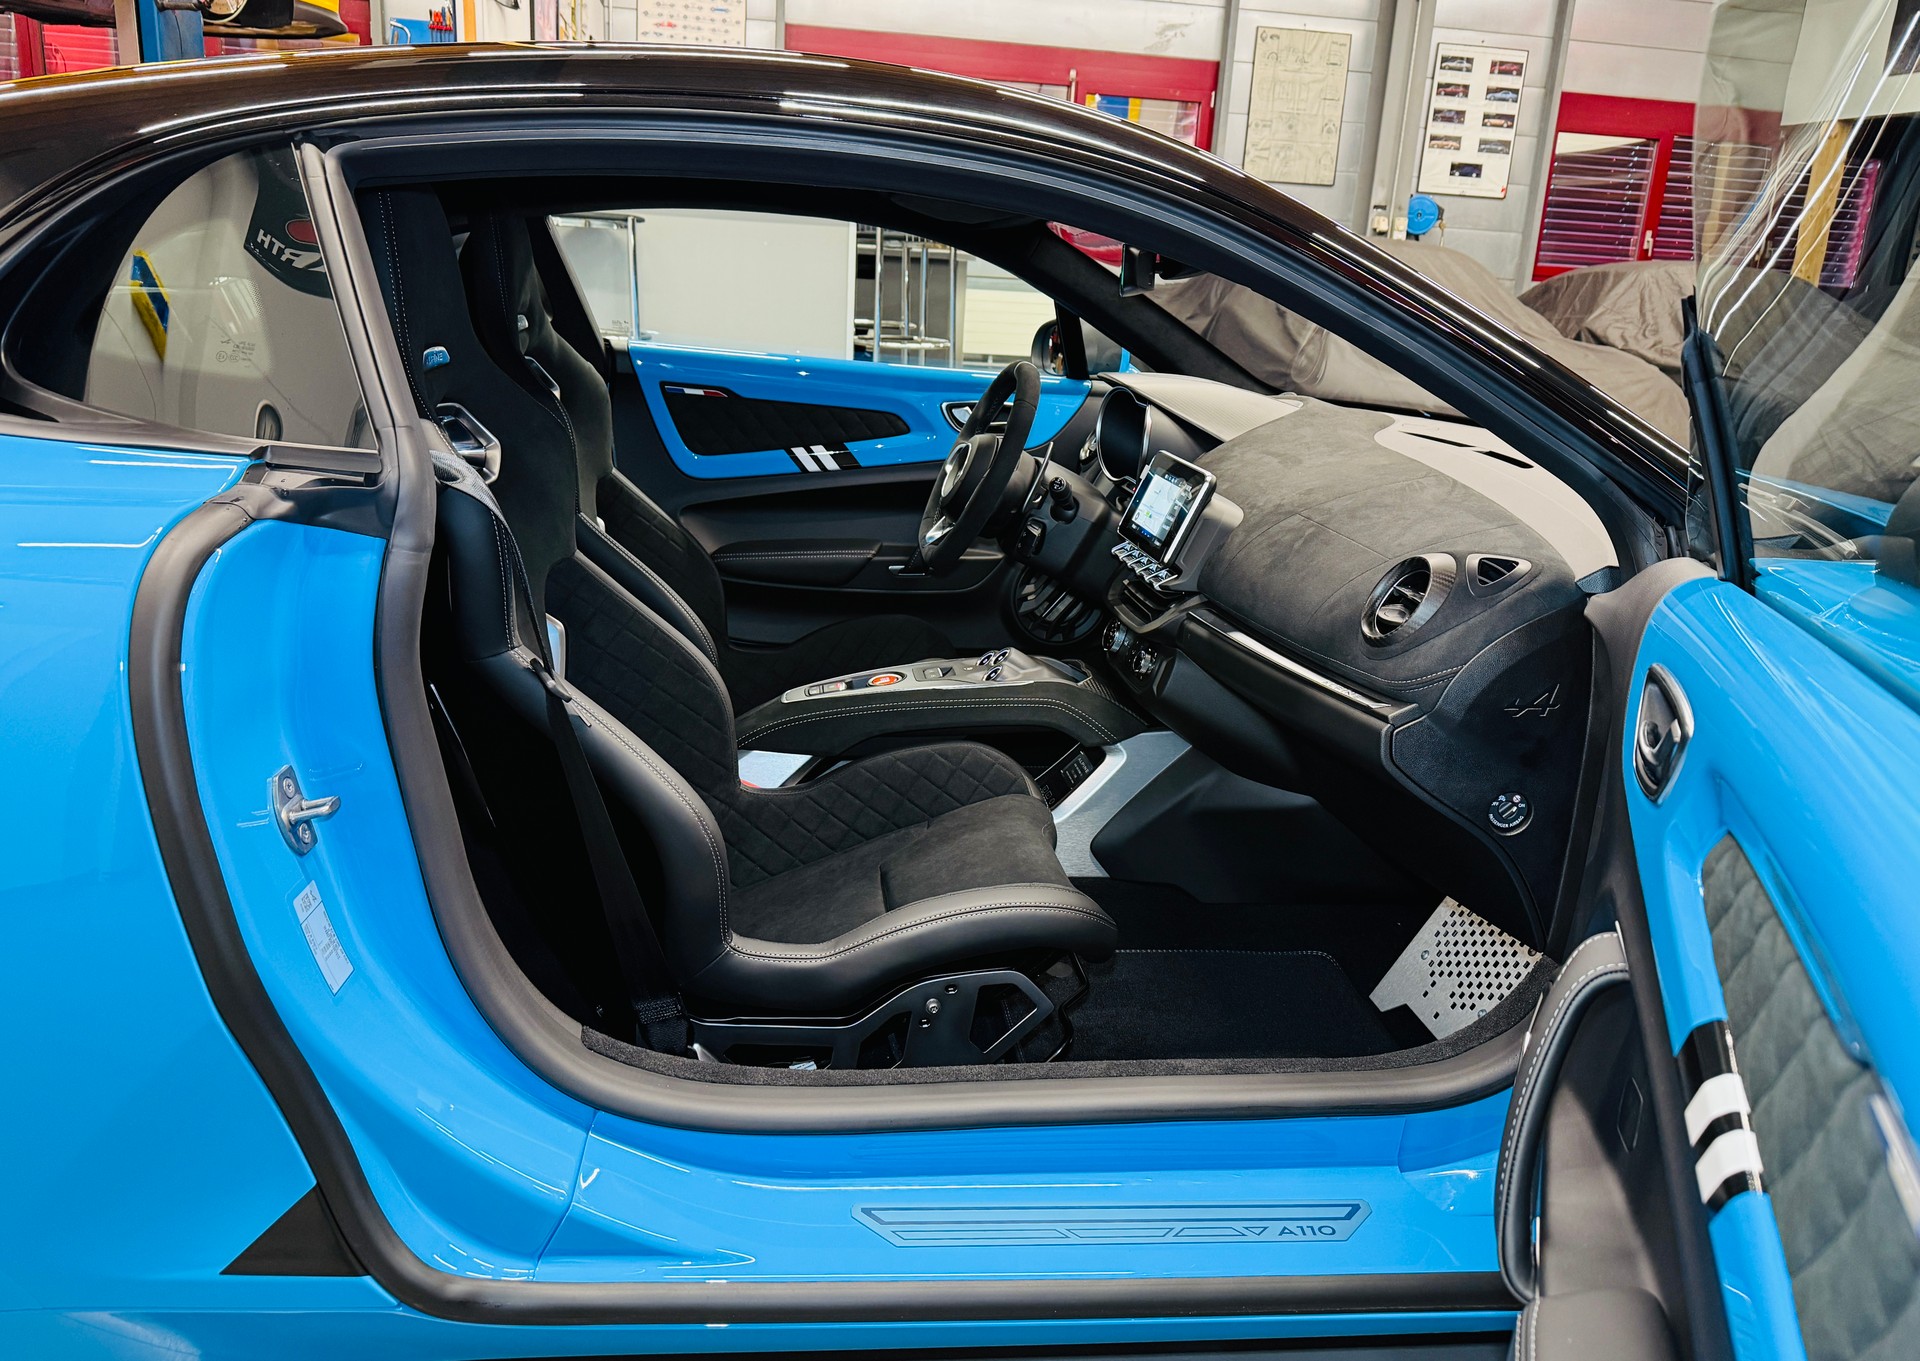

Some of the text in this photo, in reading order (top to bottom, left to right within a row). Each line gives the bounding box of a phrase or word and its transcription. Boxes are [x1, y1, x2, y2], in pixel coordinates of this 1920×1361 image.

[1488, 813, 1524, 828] PASSENGER AIRBAG
[1278, 1225, 1337, 1237] A110
